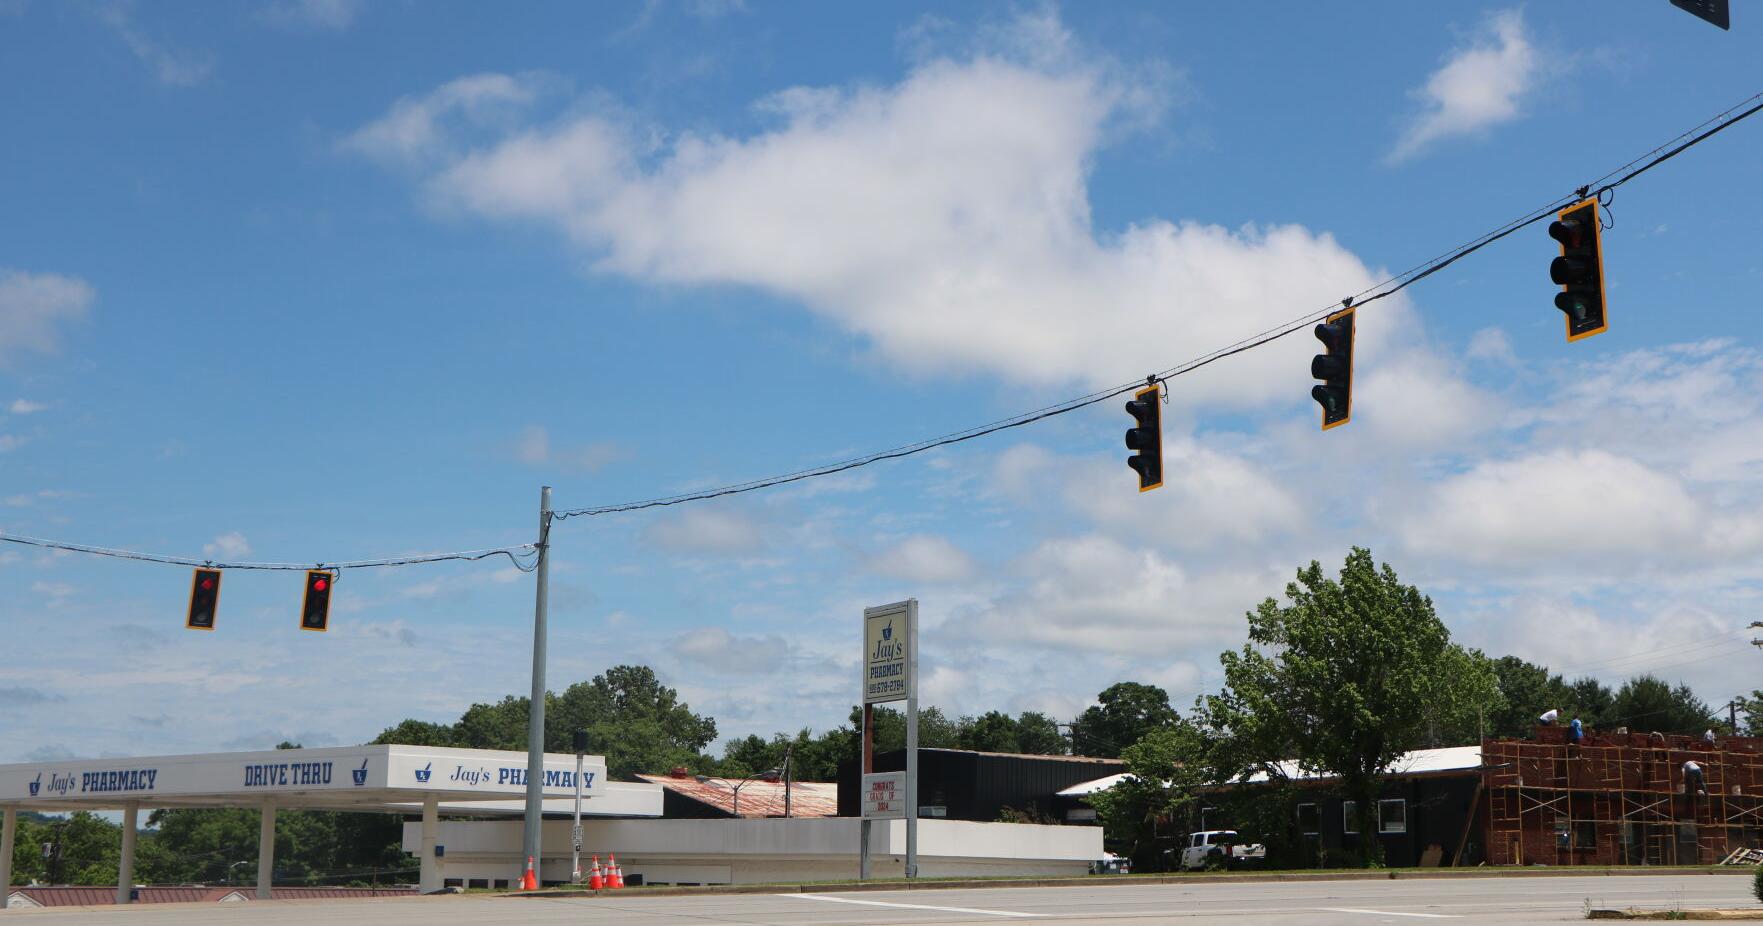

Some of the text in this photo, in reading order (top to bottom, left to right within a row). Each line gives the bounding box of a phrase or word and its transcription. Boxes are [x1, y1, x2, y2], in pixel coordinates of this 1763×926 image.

[873, 639, 902, 662] Jay's
[870, 663, 904, 679] PHARMACY
[47, 769, 157, 795] Jay's PHARMACY
[244, 762, 333, 786] DRIVE THRU
[450, 765, 595, 788] Jay's PHAMAY
